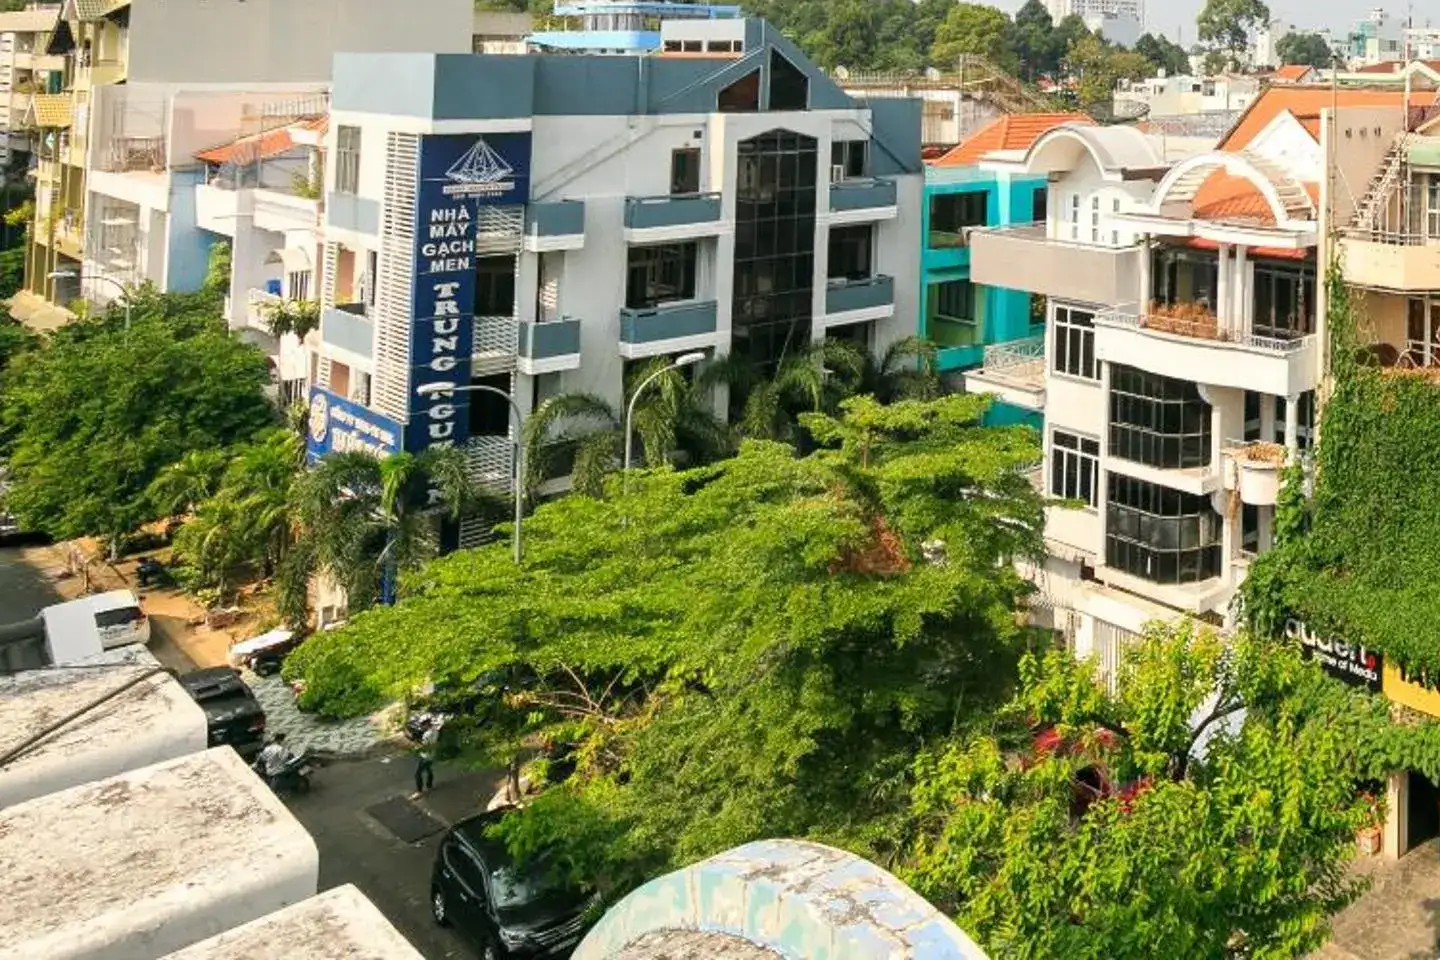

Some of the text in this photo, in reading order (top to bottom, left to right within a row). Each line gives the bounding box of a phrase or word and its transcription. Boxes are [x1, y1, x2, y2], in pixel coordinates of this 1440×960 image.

[431, 204, 471, 222] NHÀ
[421, 240, 475, 258] GẠCH
[430, 256, 470, 273] MEN
[429, 281, 461, 372] TRUNG
[1337, 659, 1349, 671] of
